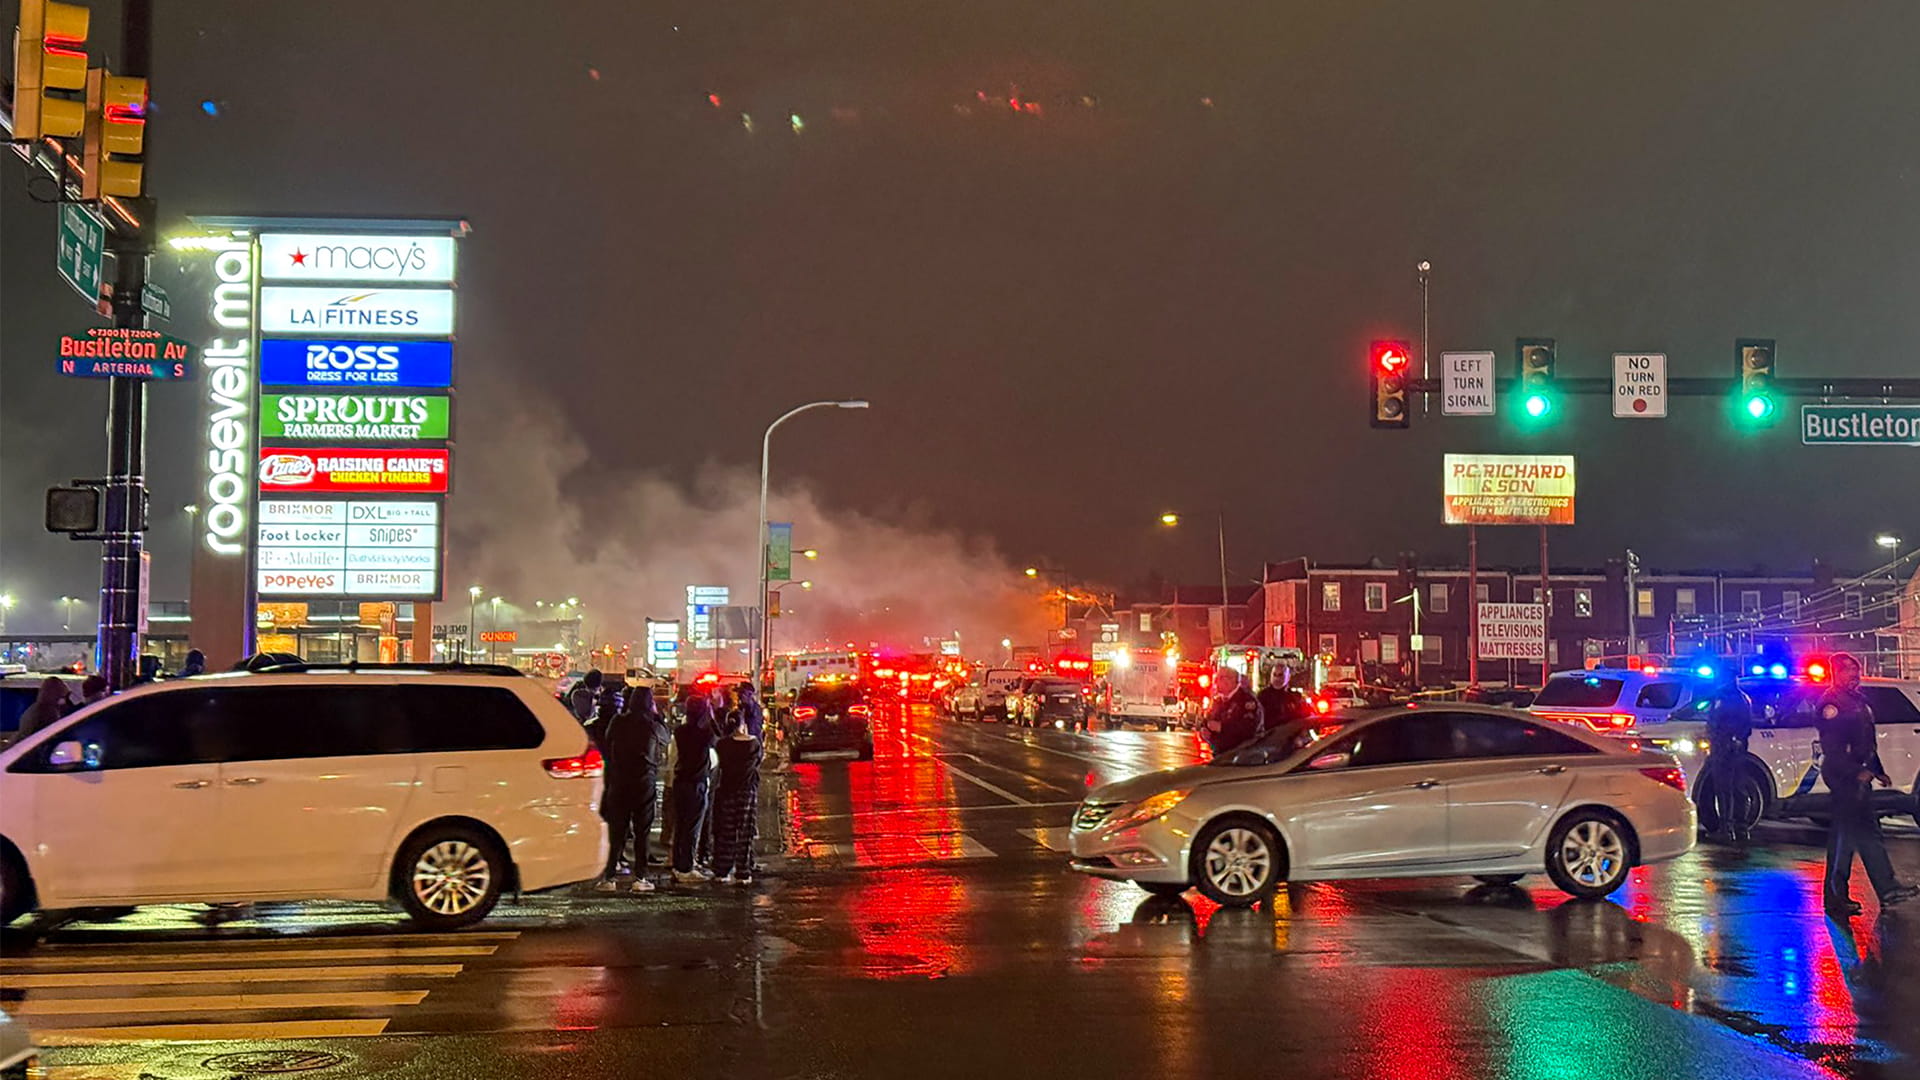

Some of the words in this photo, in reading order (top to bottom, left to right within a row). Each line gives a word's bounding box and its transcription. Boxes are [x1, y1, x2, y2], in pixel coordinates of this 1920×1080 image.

[315, 241, 426, 277] macy's
[290, 309, 315, 324] LA
[325, 309, 419, 326] FITNESS
[120, 328, 129, 339] N
[131, 330, 152, 338] 7200
[61, 336, 156, 359] Bustleton
[164, 341, 187, 359] Av
[306, 345, 399, 370] ROSS
[1628, 358, 1650, 369] NO
[62, 360, 75, 373] N
[92, 362, 153, 375] ARTERIAL
[174, 363, 184, 377] S
[1453, 360, 1482, 372] LEFT
[307, 372, 342, 381] DRESS
[345, 372, 367, 381] FOR
[371, 372, 398, 382] LESS
[1453, 378, 1484, 389] TURN
[1625, 372, 1655, 382] TURN
[1619, 385, 1635, 395] ON
[1639, 386, 1661, 396] RED
[1447, 395, 1489, 407] SIGNAL
[277, 395, 428, 423] SPROUTS
[284, 423, 354, 437] FARMERS
[355, 424, 421, 438] MARKET
[204, 338, 249, 554] roosevelt
[317, 458, 384, 472] RAISING
[387, 458, 444, 473] CANE'S
[1483, 464, 1566, 479] RICHARD
[330, 472, 378, 483] CHICKEN
[381, 472, 431, 483] FINGERS
[1482, 479, 1492, 492] &
[1496, 480, 1535, 493] SON
[1452, 497, 1504, 506] APPLIANCES
[269, 504, 333, 515] BRIXMOR
[353, 506, 387, 520] DXL
[260, 529, 290, 541] Foot
[295, 529, 342, 541] Locker
[357, 574, 421, 584] BRIXMOR
[1480, 606, 1543, 620] APPLIANCES
[1480, 624, 1543, 638] TELEVISIONS
[1480, 642, 1543, 656] MATTRESSES
